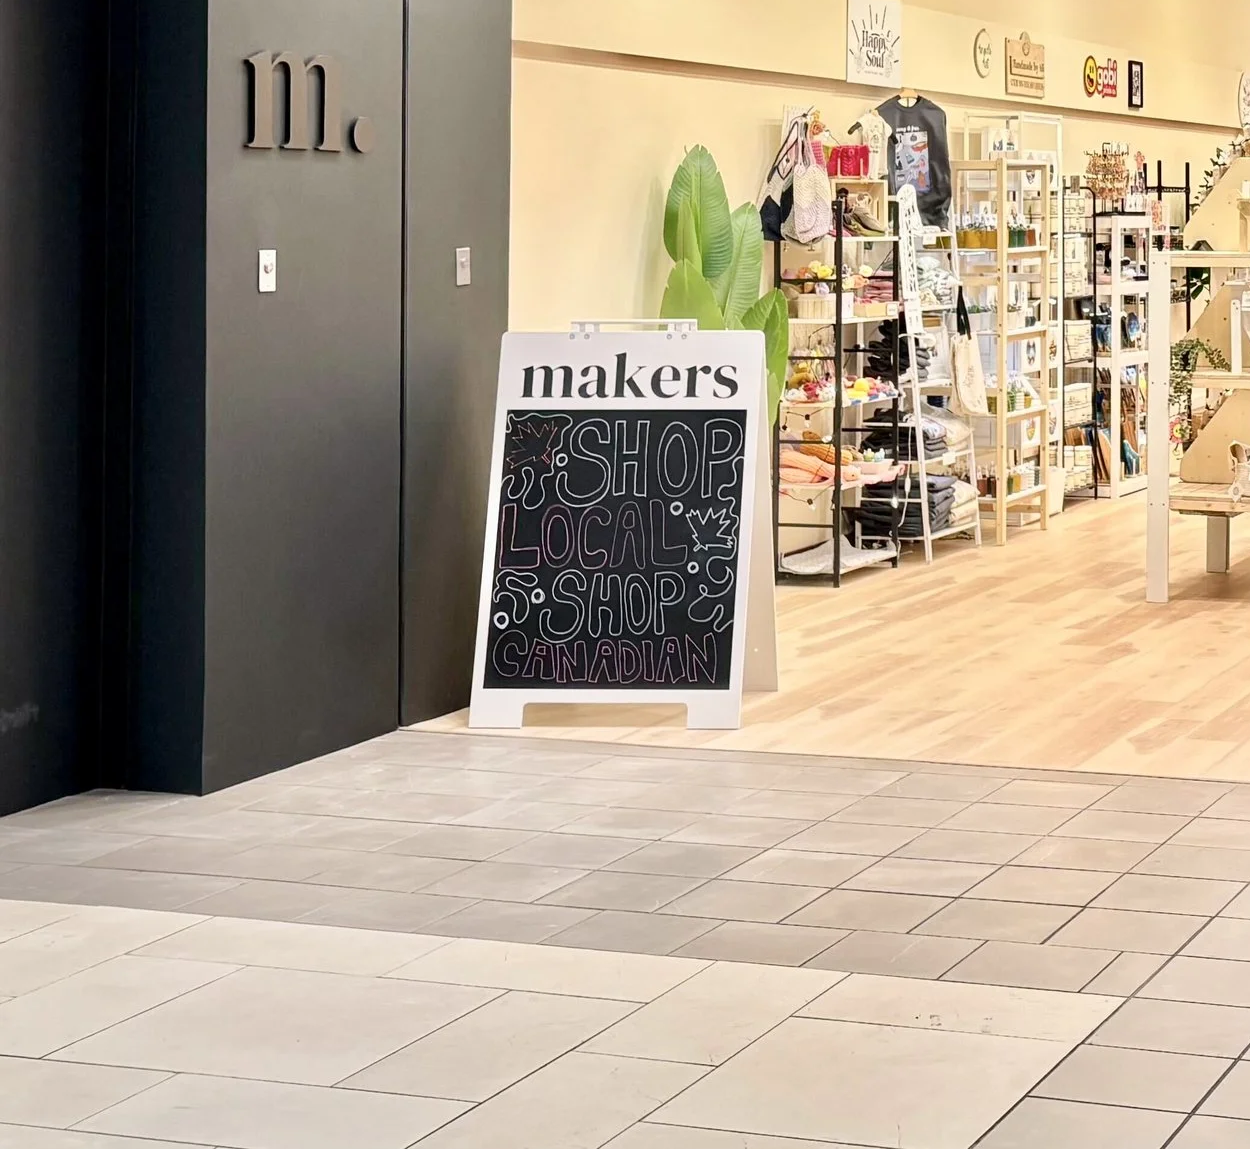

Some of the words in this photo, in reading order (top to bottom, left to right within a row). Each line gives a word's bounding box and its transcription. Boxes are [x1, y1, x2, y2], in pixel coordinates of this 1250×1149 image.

[866, 50, 886, 68] Soul
[520, 352, 739, 398] makers
[555, 417, 744, 507] SHOP
[499, 499, 688, 570] LOCAL
[539, 569, 686, 642] SHOP
[494, 629, 717, 684] CANADIAN
